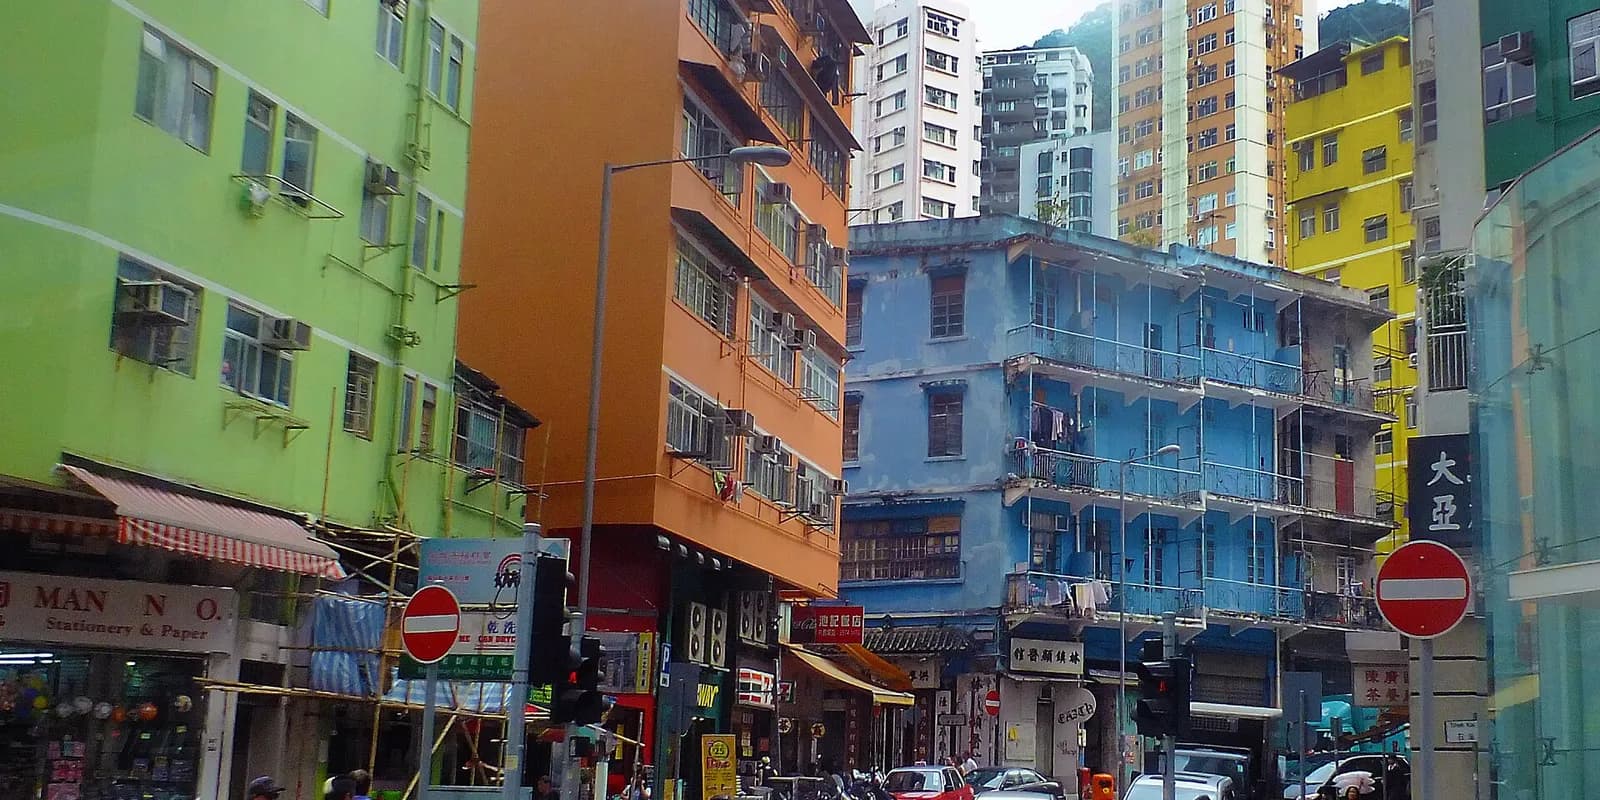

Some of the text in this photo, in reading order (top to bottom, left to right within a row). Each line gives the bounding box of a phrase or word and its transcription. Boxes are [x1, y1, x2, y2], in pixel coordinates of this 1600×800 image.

[34, 586, 107, 613] MAN
[46, 616, 208, 641] Stationery & Paper
